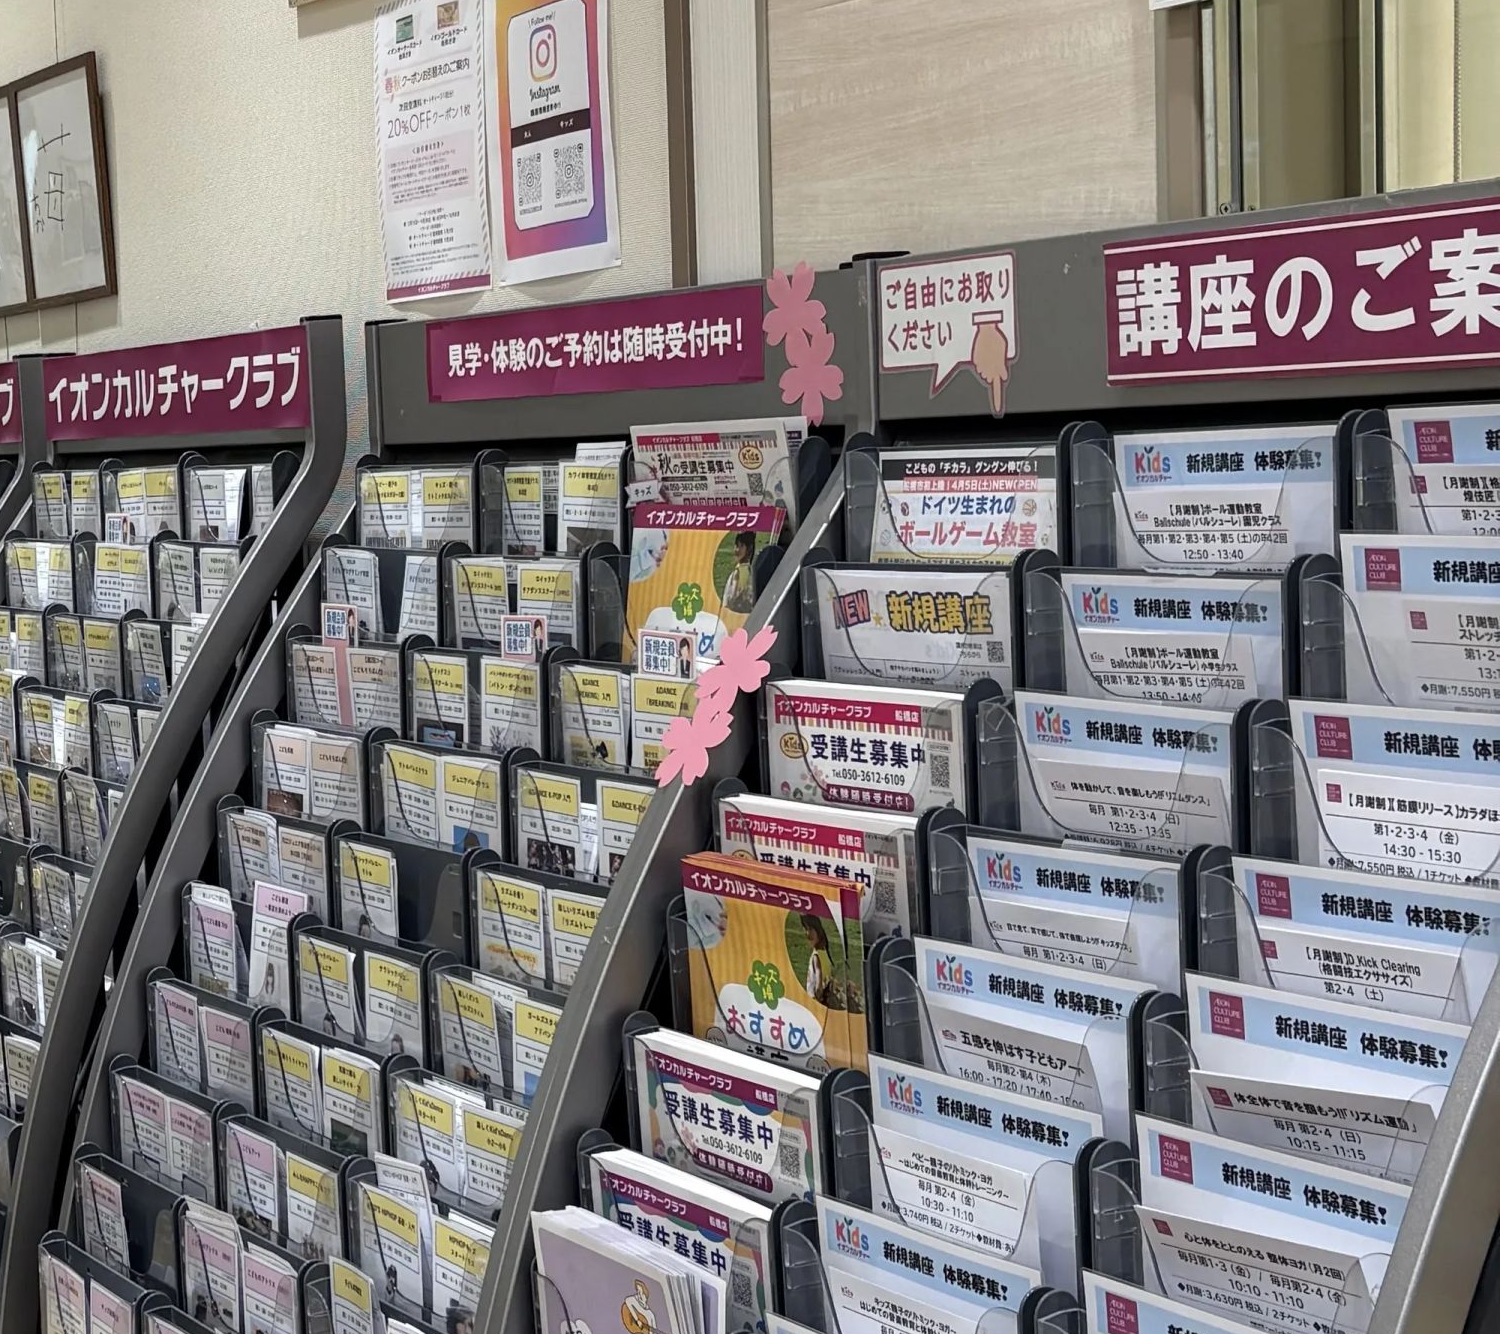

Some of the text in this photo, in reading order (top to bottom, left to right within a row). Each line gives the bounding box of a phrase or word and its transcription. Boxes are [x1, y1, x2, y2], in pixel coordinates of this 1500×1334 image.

[530, 85, 560, 102] Instagram
[885, 266, 1011, 312] ご自由にお取り
[1116, 227, 1500, 358] 講座のご案
[448, 317, 743, 377] 見学・体験のご予約は随時受付中!
[886, 320, 952, 353] ください
[48, 346, 301, 423] イオンカルチャークラブ
[1134, 446, 1171, 474] Kids
[1186, 452, 1244, 473] 新規講座
[635, 487, 651, 495] キッズ
[921, 495, 1016, 516] ドイツ生まれの
[647, 511, 759, 527] イオンカルチャークラブ
[900, 521, 1037, 548] ボールゲーム教室
[1183, 550, 1243, 560] 12:50 13:40
[833, 590, 993, 635] NEW 新規講座
[1082, 587, 1119, 615] Kids
[1134, 597, 1192, 620] 新規講座
[645, 640, 676, 657] 新規会員
[645, 656, 671, 672] 募集中!
[777, 700, 871, 718] イオンカルチャークラブ
[1035, 706, 1071, 735] Kids
[1086, 720, 1143, 745] 新規講座
[1384, 731, 1460, 758] 新規講座
[811, 734, 926, 769] 受講生募集中
[727, 817, 817, 840] イオンカルチャークラブ
[1109, 821, 1137, 835] 12:35
[986, 853, 1022, 882] Kids
[1383, 844, 1461, 864] 14:30 15:30
[691, 870, 812, 910] イオンカルチャークラブ
[1036, 868, 1092, 893] 新規講座
[1321, 892, 1394, 924] 新規講座
[936, 955, 973, 987] Kids
[1381, 959, 1421, 977] Clearing
[989, 973, 1045, 1004] 新規講座
[727, 1004, 810, 1049] おすすめ
[1275, 1015, 1448, 1069] 新規講座 体験募集!
[649, 1055, 732, 1090] イオンカルチャークラブ
[887, 1074, 922, 1107] Kids
[664, 1090, 774, 1150] 受講生募集中
[936, 1095, 993, 1129] 新規講座
[1287, 1136, 1366, 1161] 10:15 11:15
[603, 1174, 687, 1215] イオンカルチャークラブ
[1222, 1162, 1388, 1225] 新規講座 体験募集!
[921, 1196, 974, 1223] 10:30 11:10
[883, 1240, 935, 1278] 新規講座
[1229, 1279, 1304, 1309] 10:10 11:10
